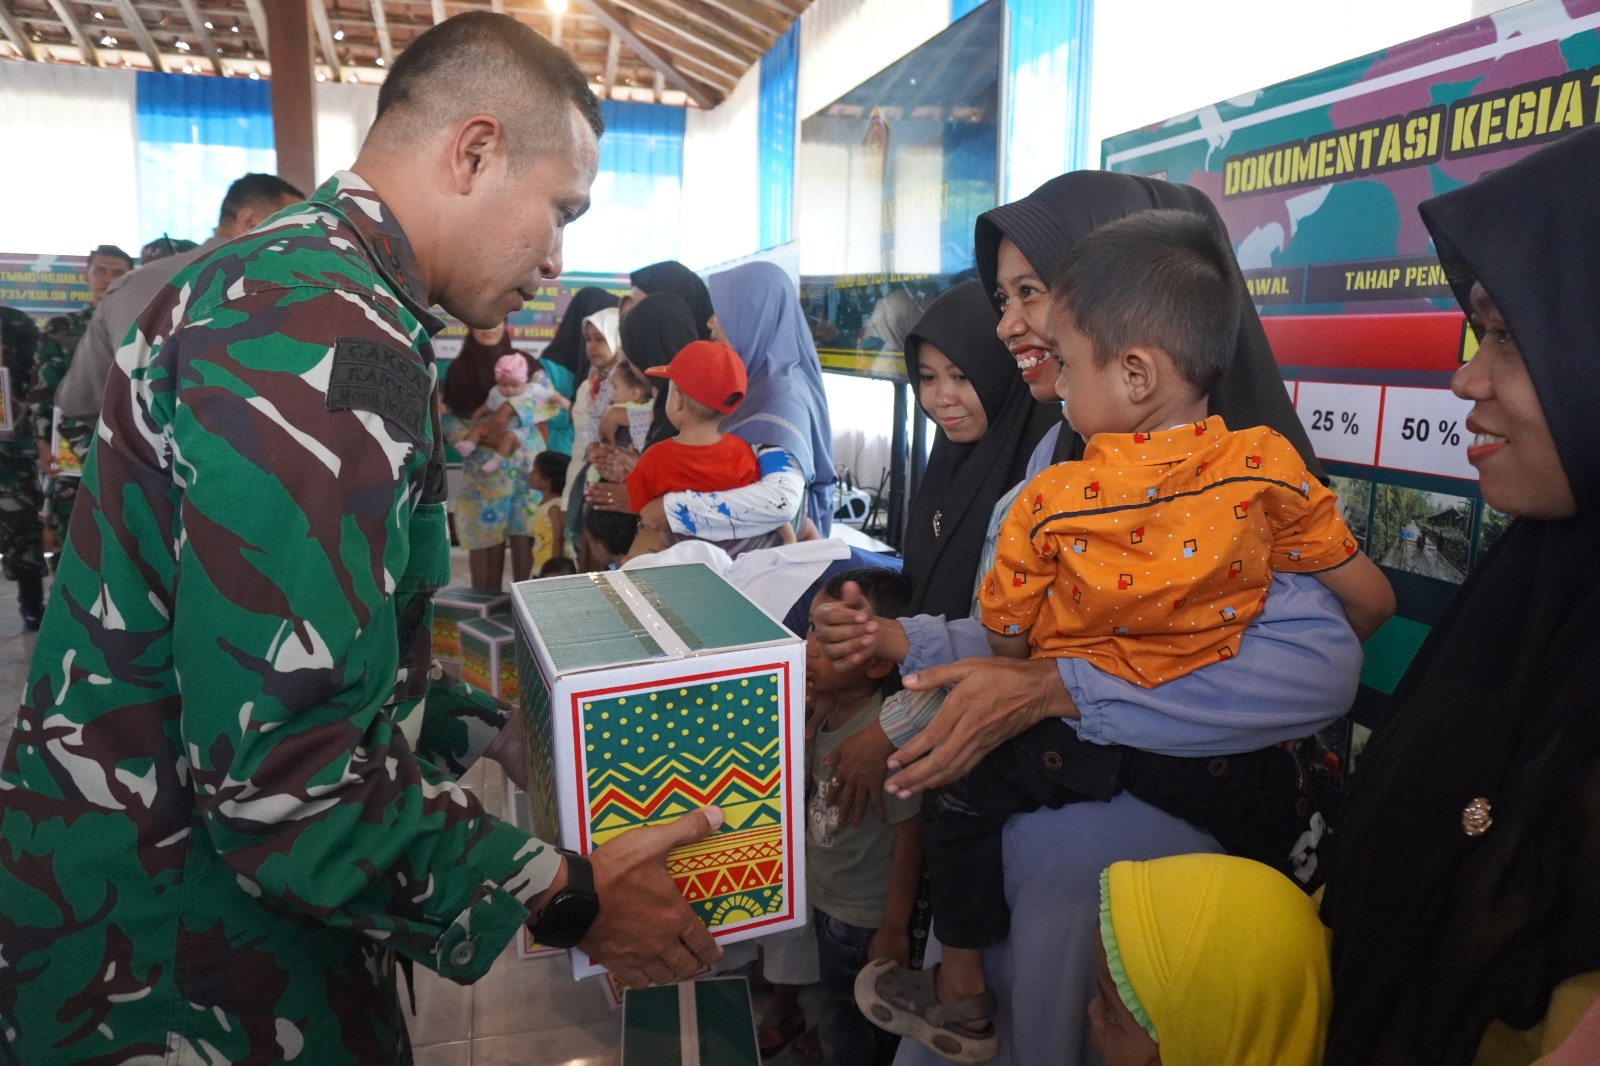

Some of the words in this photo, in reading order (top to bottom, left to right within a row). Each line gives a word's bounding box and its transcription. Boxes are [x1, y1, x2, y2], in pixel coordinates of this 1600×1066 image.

[1225, 113, 1441, 196] DOKUMENTASI
[1247, 277, 1290, 296] AWAL
[1345, 268, 1400, 290] TAHAP
[1311, 410, 1334, 432] 25
[1341, 412, 1359, 435] %
[1401, 417, 1430, 442] 50
[1438, 420, 1460, 446] %
